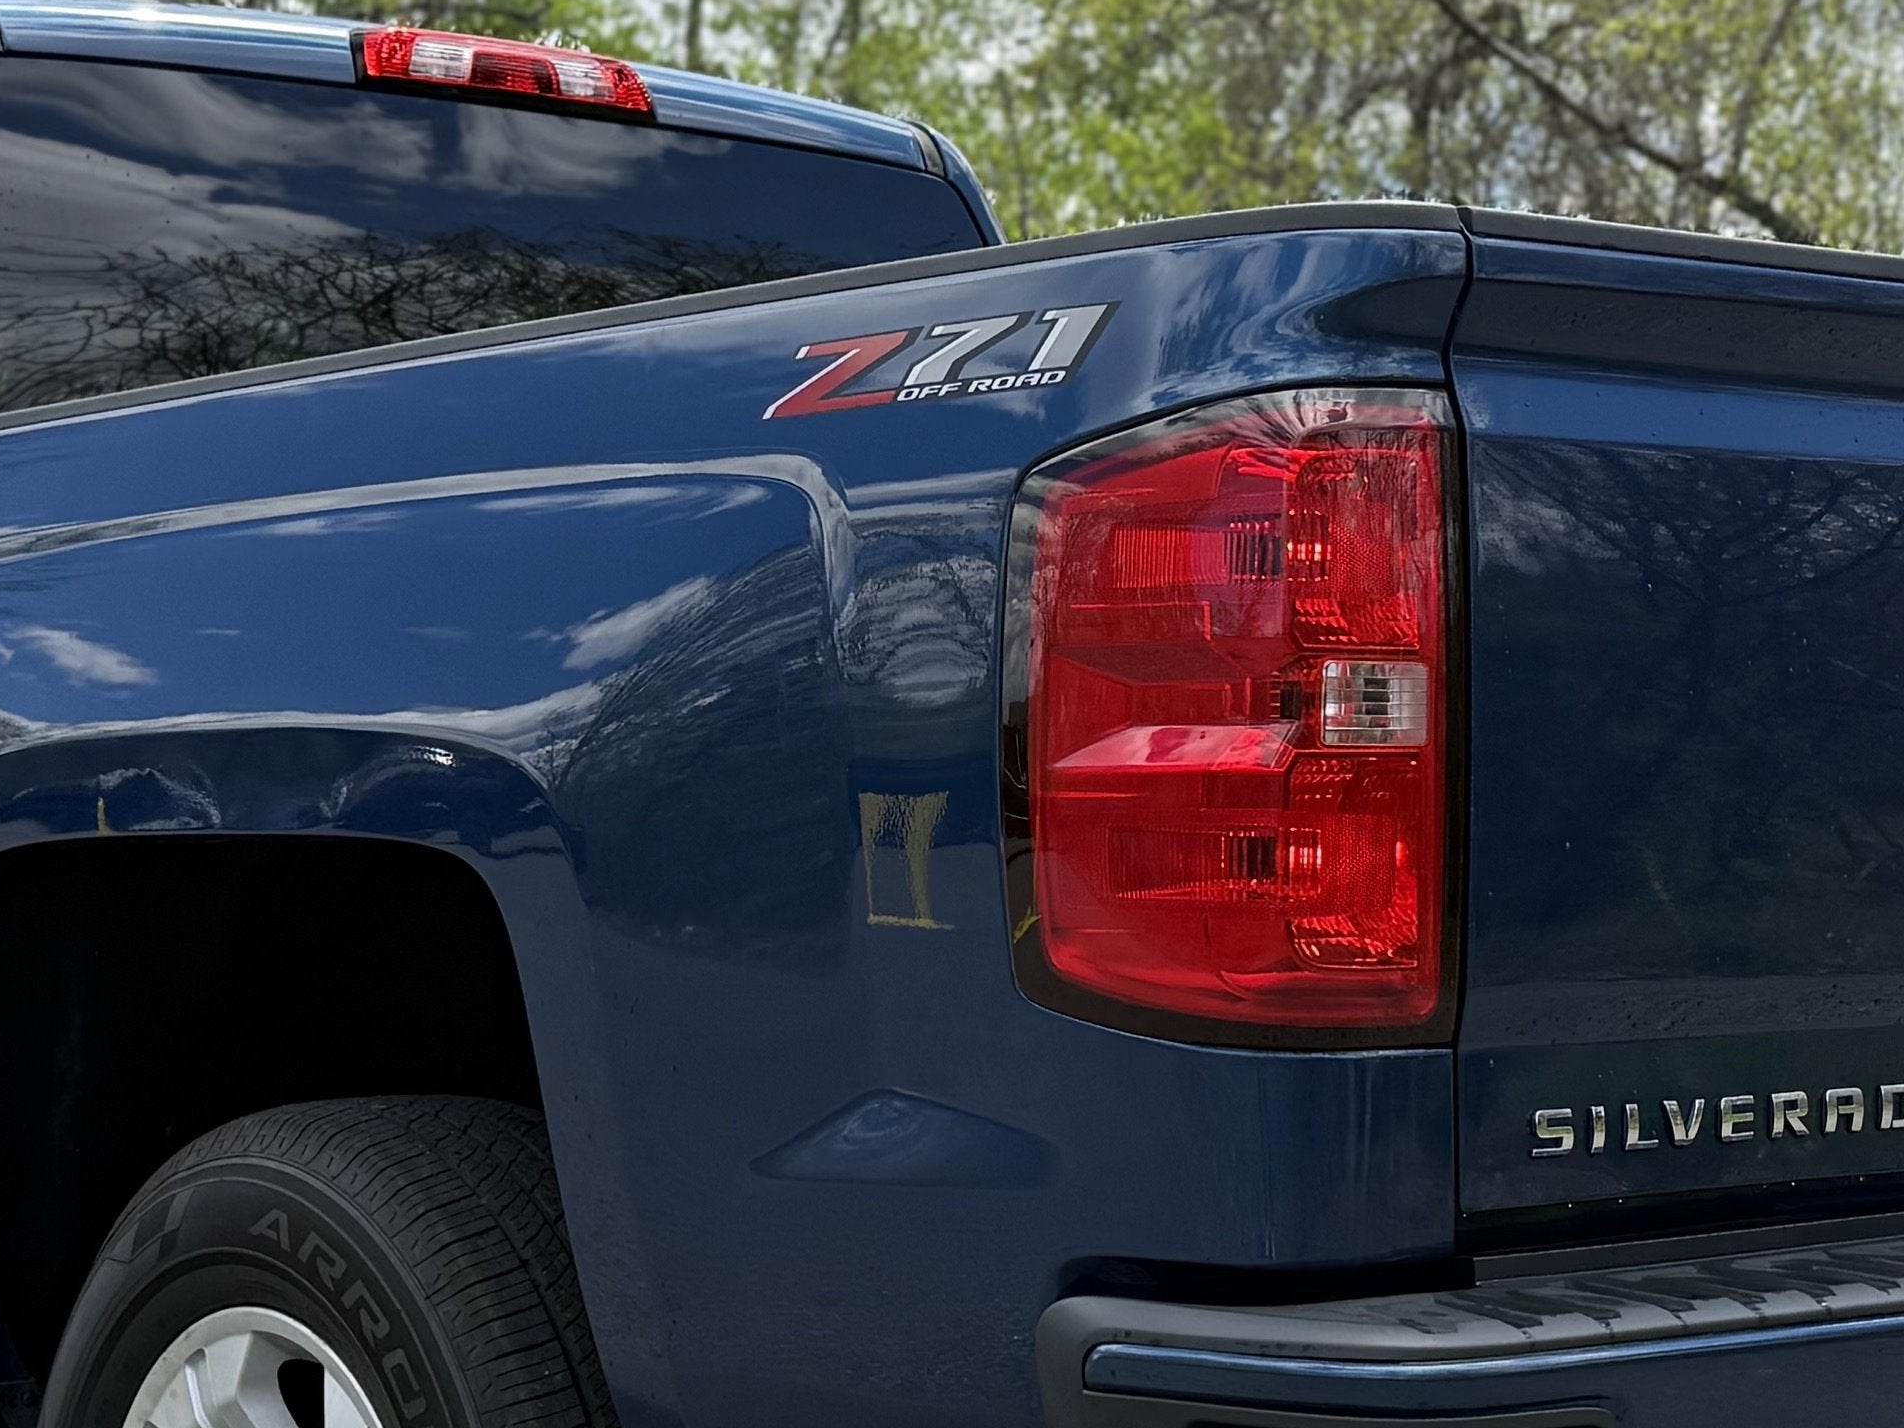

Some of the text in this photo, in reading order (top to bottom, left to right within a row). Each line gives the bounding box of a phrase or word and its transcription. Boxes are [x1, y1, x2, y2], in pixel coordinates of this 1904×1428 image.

[762, 301, 1121, 420] Z71
[896, 369, 1066, 403] OFF ROAD
